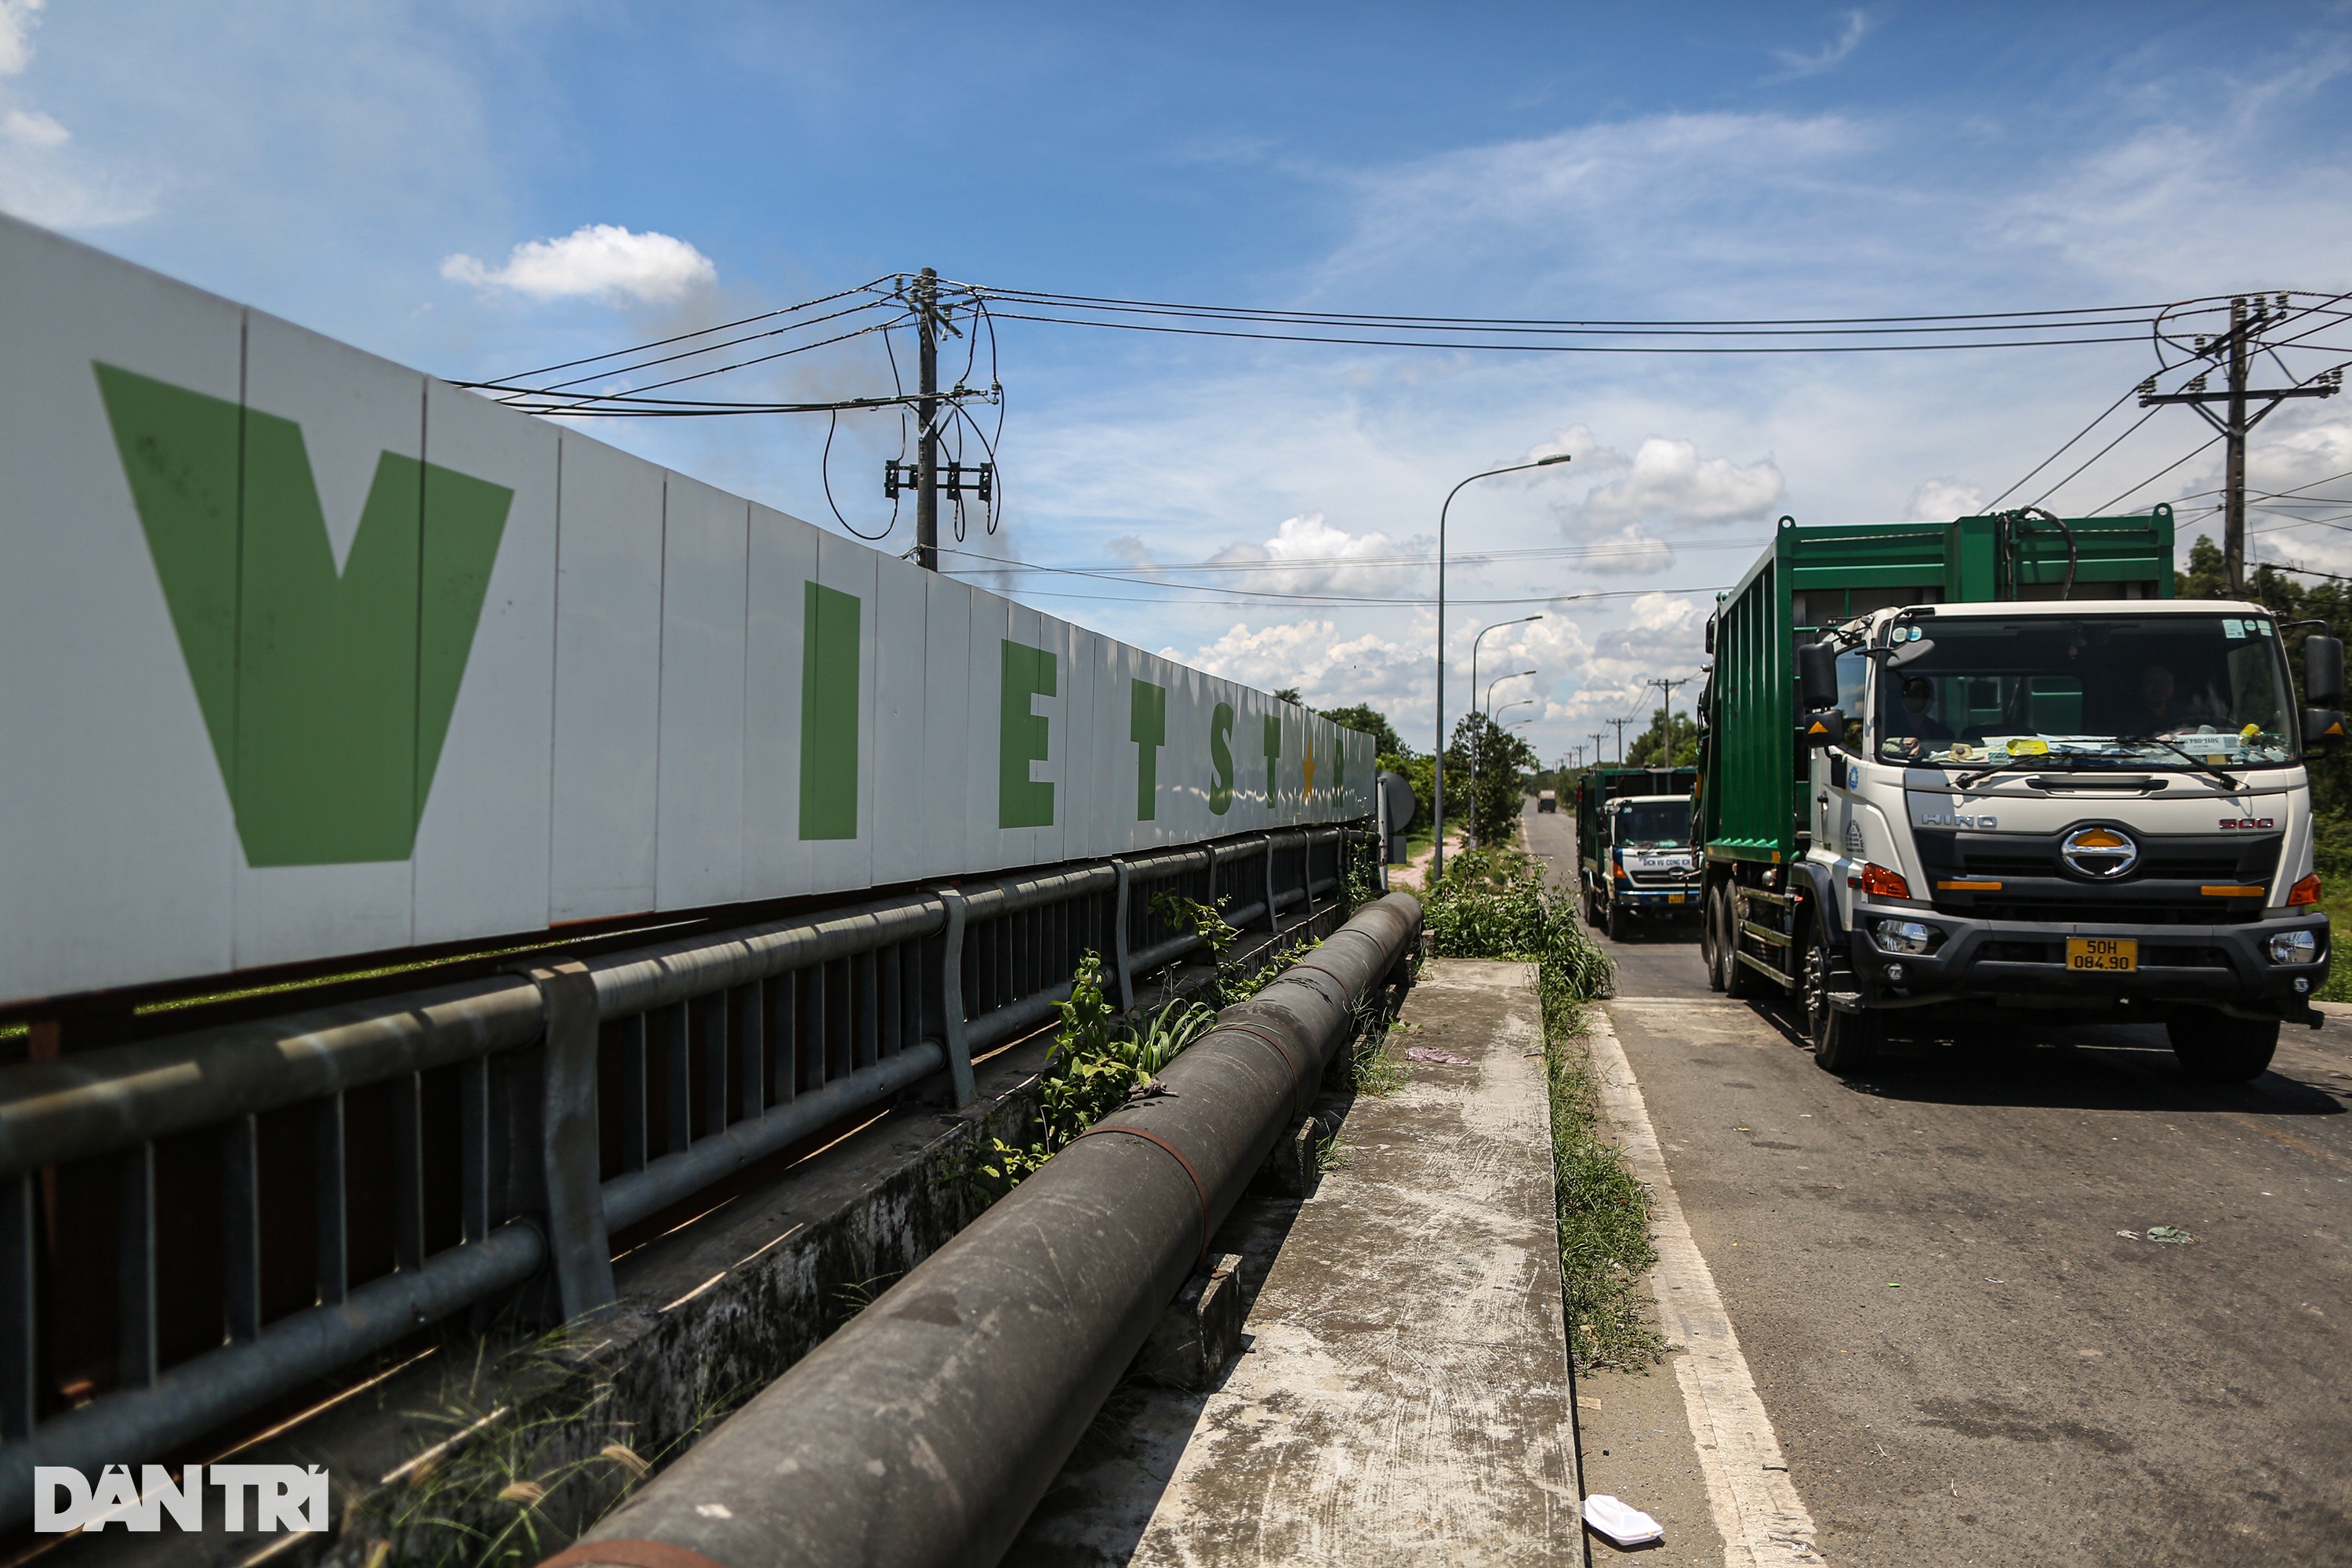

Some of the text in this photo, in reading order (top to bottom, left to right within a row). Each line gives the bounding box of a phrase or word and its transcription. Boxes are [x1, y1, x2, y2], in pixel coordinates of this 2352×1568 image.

[1921, 814, 1997, 827] HINO
[2219, 818, 2274, 829] 500
[2087, 940, 2117, 954] 50H
[2074, 955, 2129, 970] 084.90
